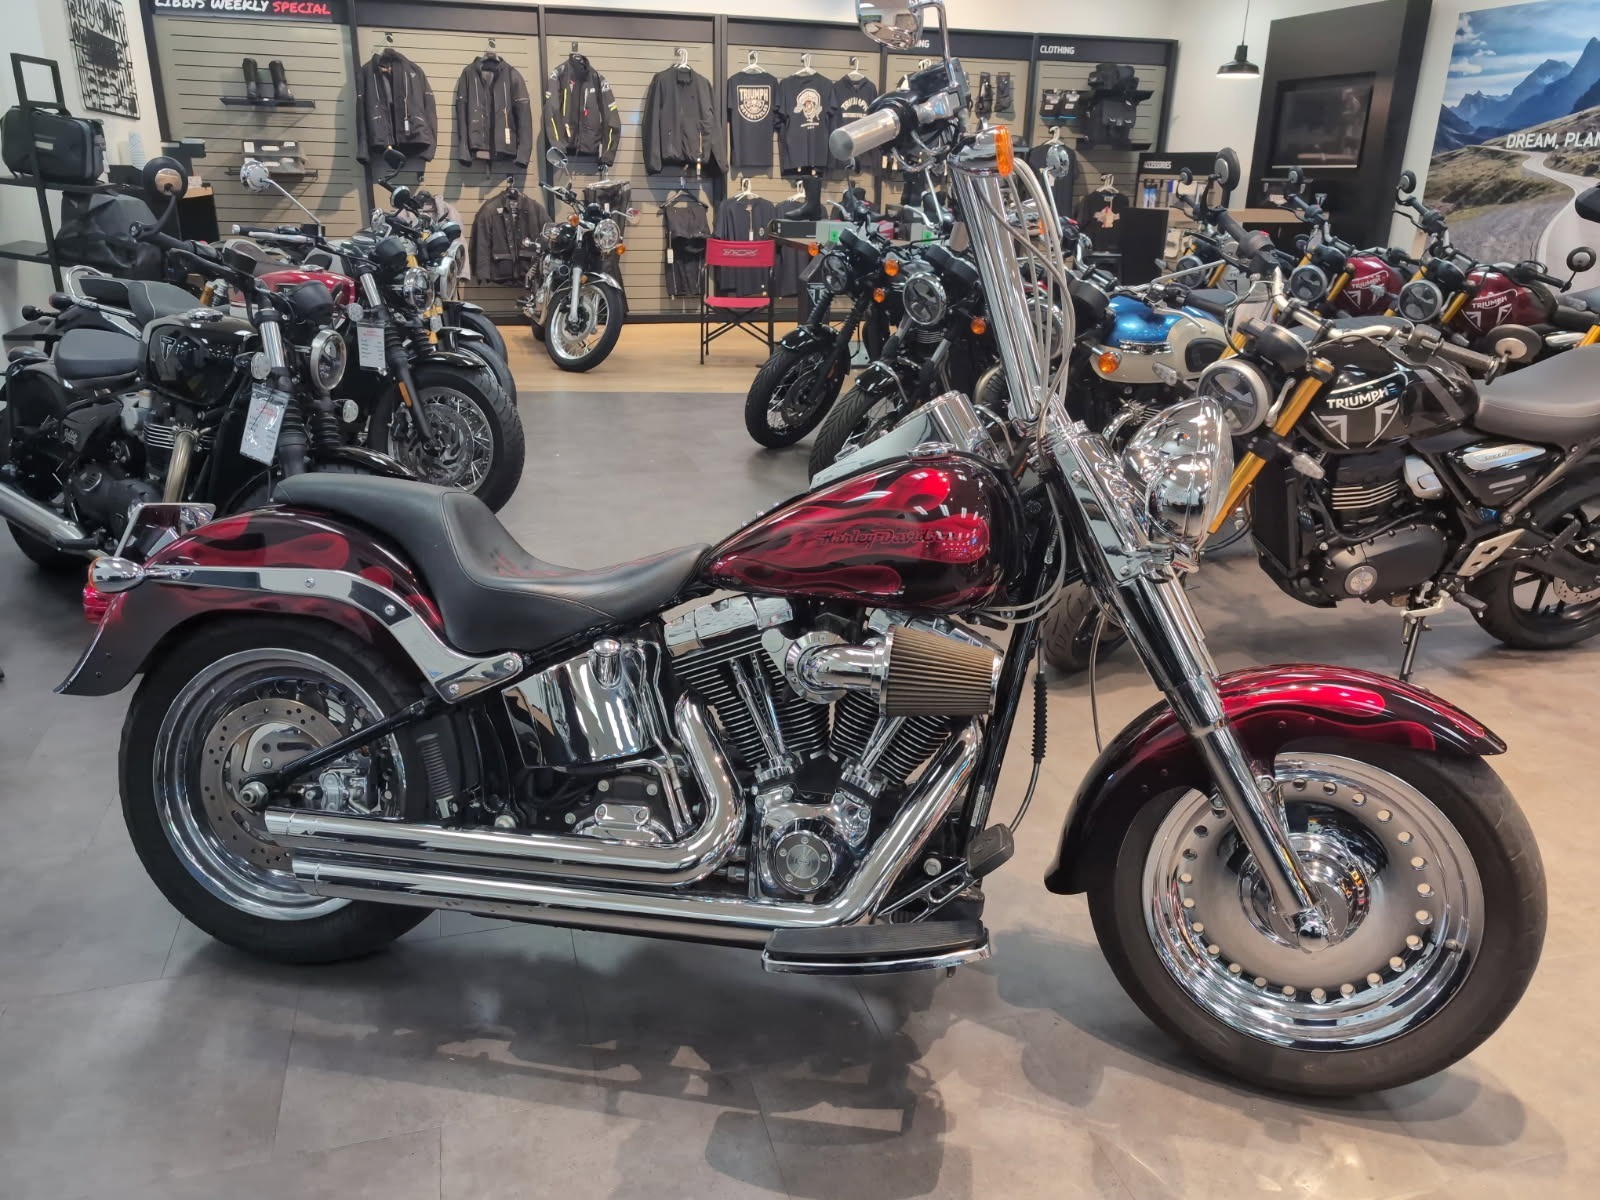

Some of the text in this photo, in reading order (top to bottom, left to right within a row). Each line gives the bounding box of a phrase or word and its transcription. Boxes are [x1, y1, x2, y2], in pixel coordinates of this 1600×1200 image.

[210, 0, 269, 12] WEEKLY
[272, 1, 331, 14] SPECIAL
[1040, 44, 1075, 55] CLOTHING
[739, 88, 768, 102] TRIUMPH
[1506, 133, 1559, 150] DREAM,
[1472, 295, 1508, 309] TRIUMPH
[1326, 387, 1389, 410] TRIUMPH
